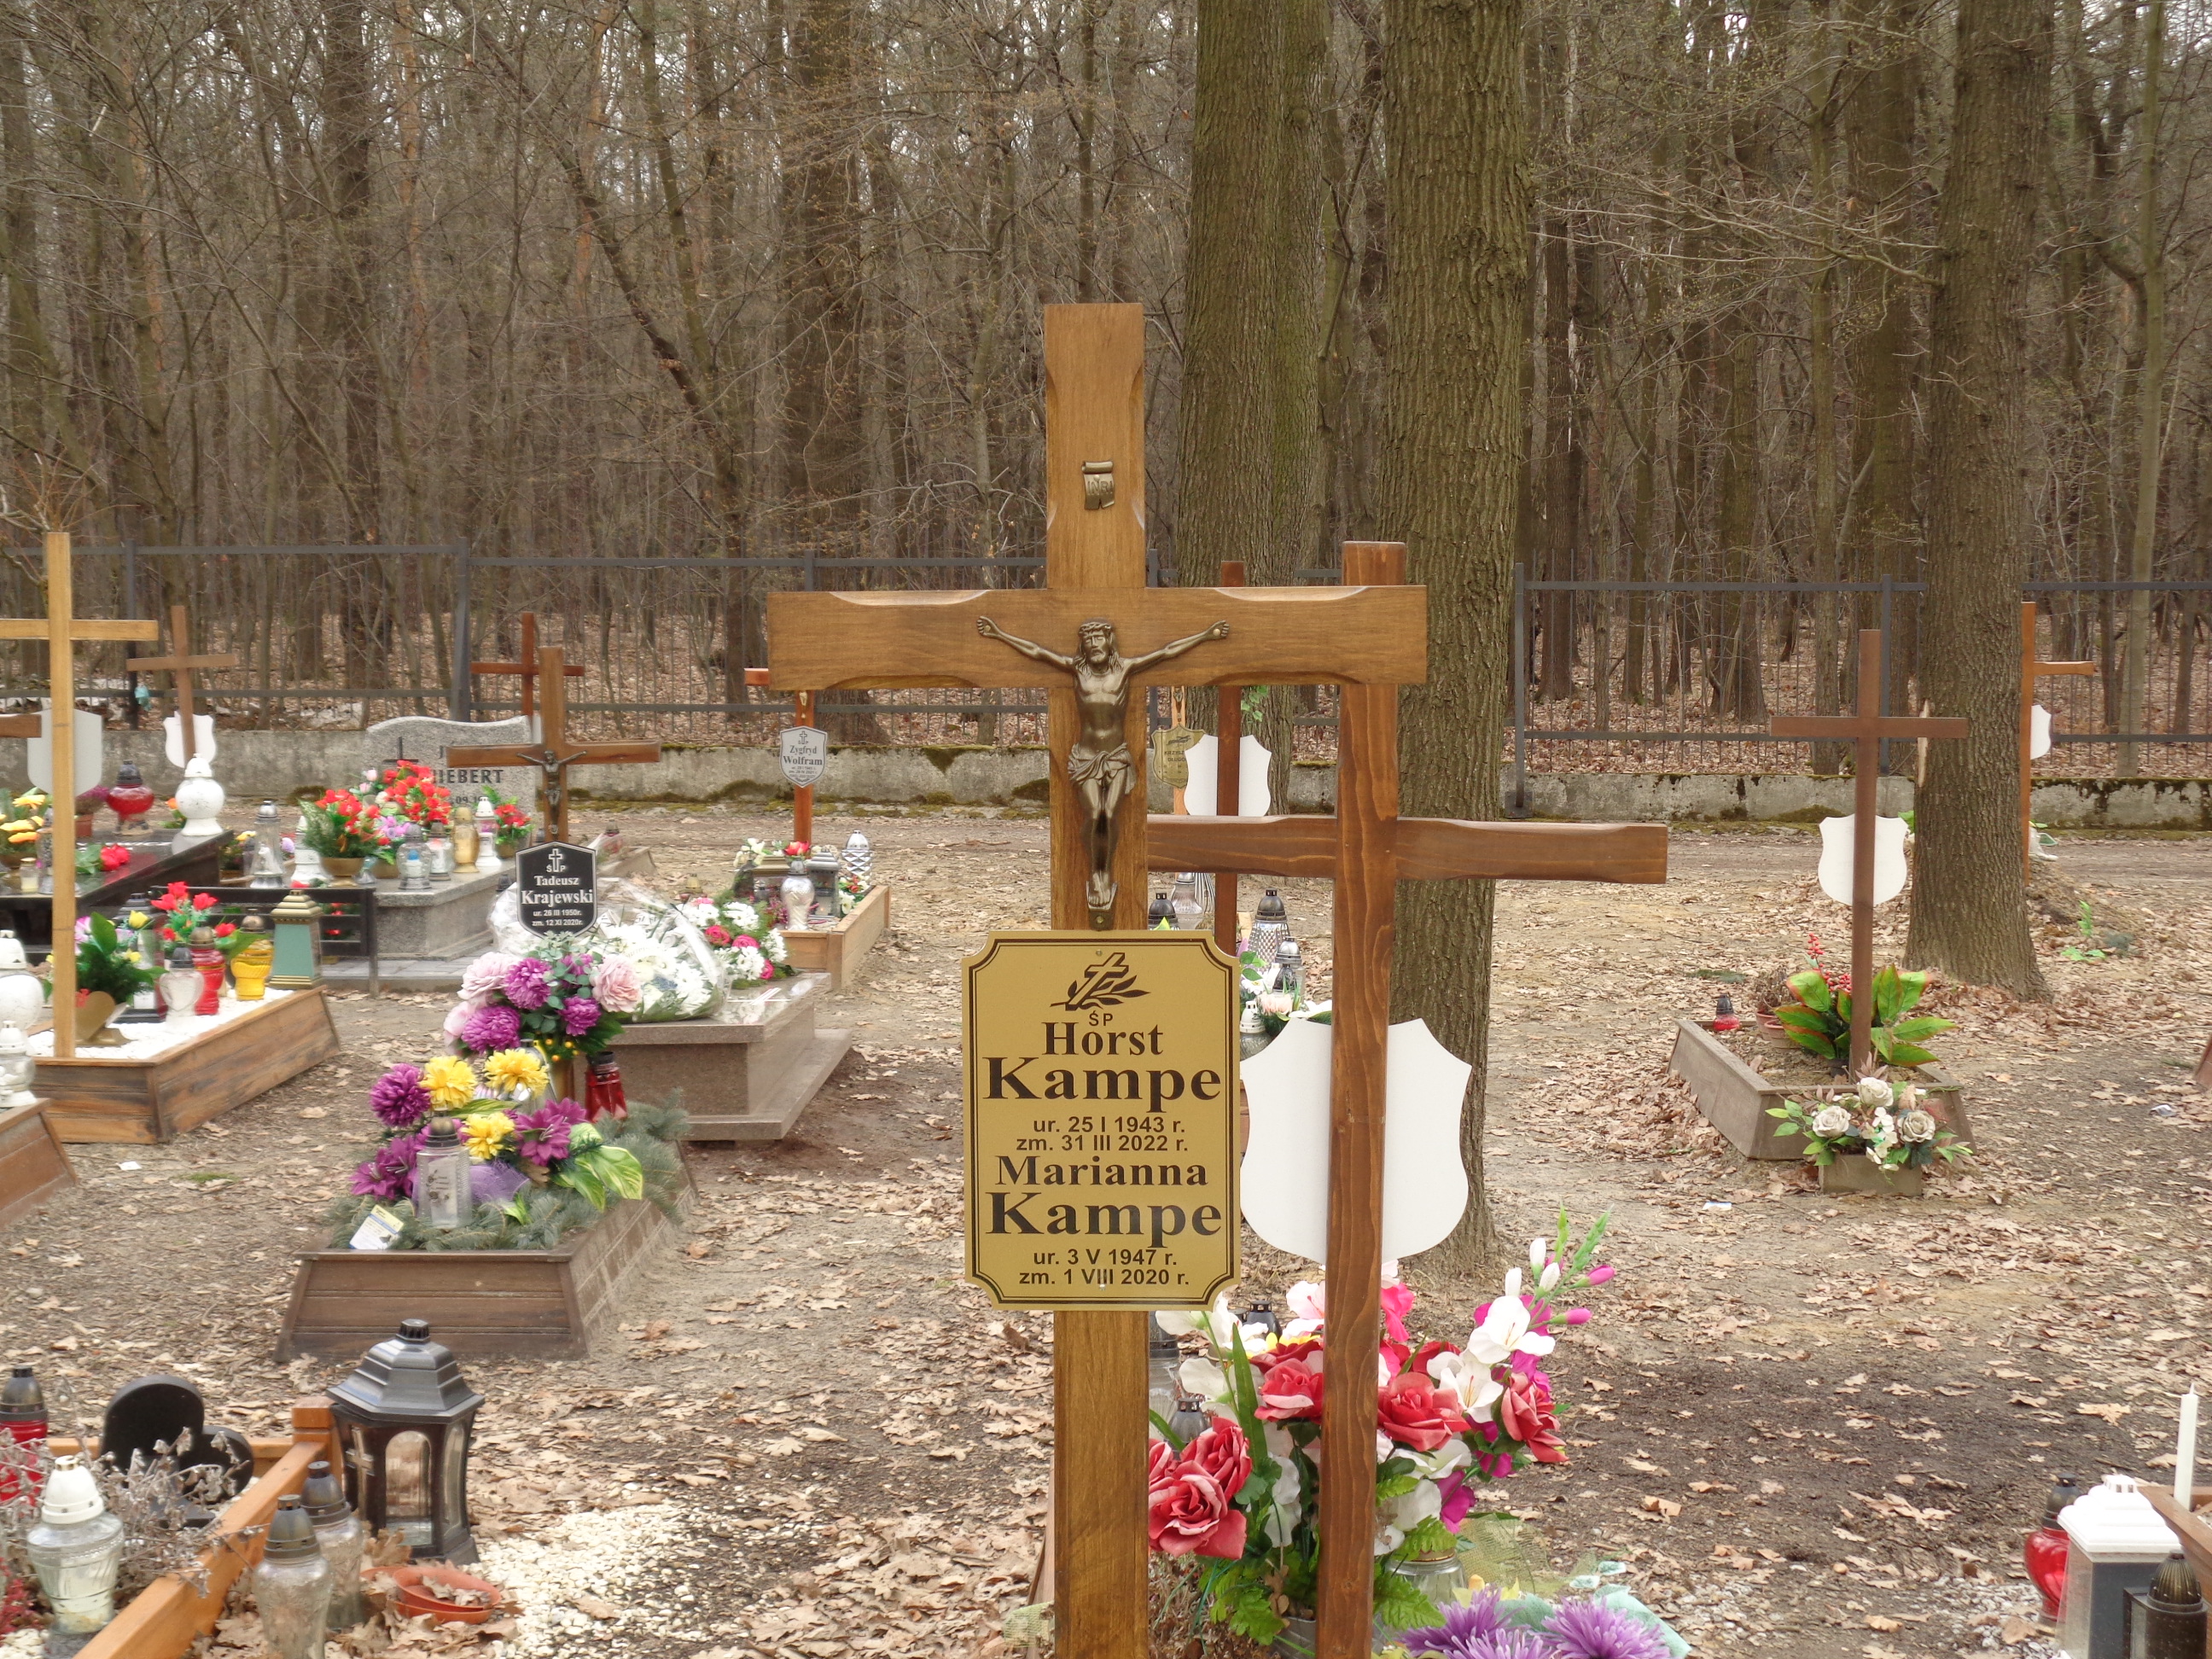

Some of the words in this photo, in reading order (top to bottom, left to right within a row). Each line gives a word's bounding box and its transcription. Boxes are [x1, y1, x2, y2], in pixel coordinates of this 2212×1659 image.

[1087, 480, 1113, 495] INRI
[789, 745, 817, 755] Zygfryd
[783, 756, 823, 765] Wolfram
[533, 875, 579, 886] Tadeusz
[521, 889, 594, 907] Krajewski
[1042, 1022, 1164, 1056] Horst
[982, 1057, 1221, 1113] Kampe
[1033, 1121, 1060, 1132] ur.
[1068, 1116, 1093, 1132] 25
[1115, 1116, 1165, 1132] 1943
[1173, 1121, 1185, 1132] r.
[1016, 1139, 1053, 1151] zm.
[1062, 1135, 1083, 1151] 31
[1093, 1135, 1110, 1151] III
[1118, 1135, 1167, 1151] 2022
[1177, 1139, 1188, 1151] r.
[995, 1155, 1208, 1186] Marianna
[986, 1192, 1222, 1249] Kampe
[1033, 1252, 1060, 1265] ur.
[1068, 1249, 1080, 1265] 3
[1086, 1249, 1101, 1265] V
[1108, 1249, 1156, 1265] 1947
[1165, 1253, 1177, 1265] r.
[1019, 1272, 1056, 1284] zm.
[1064, 1269, 1072, 1285] 1
[1081, 1268, 1114, 1285] VIII
[1121, 1269, 1170, 1285] 2020
[1178, 1273, 1189, 1285] r.
